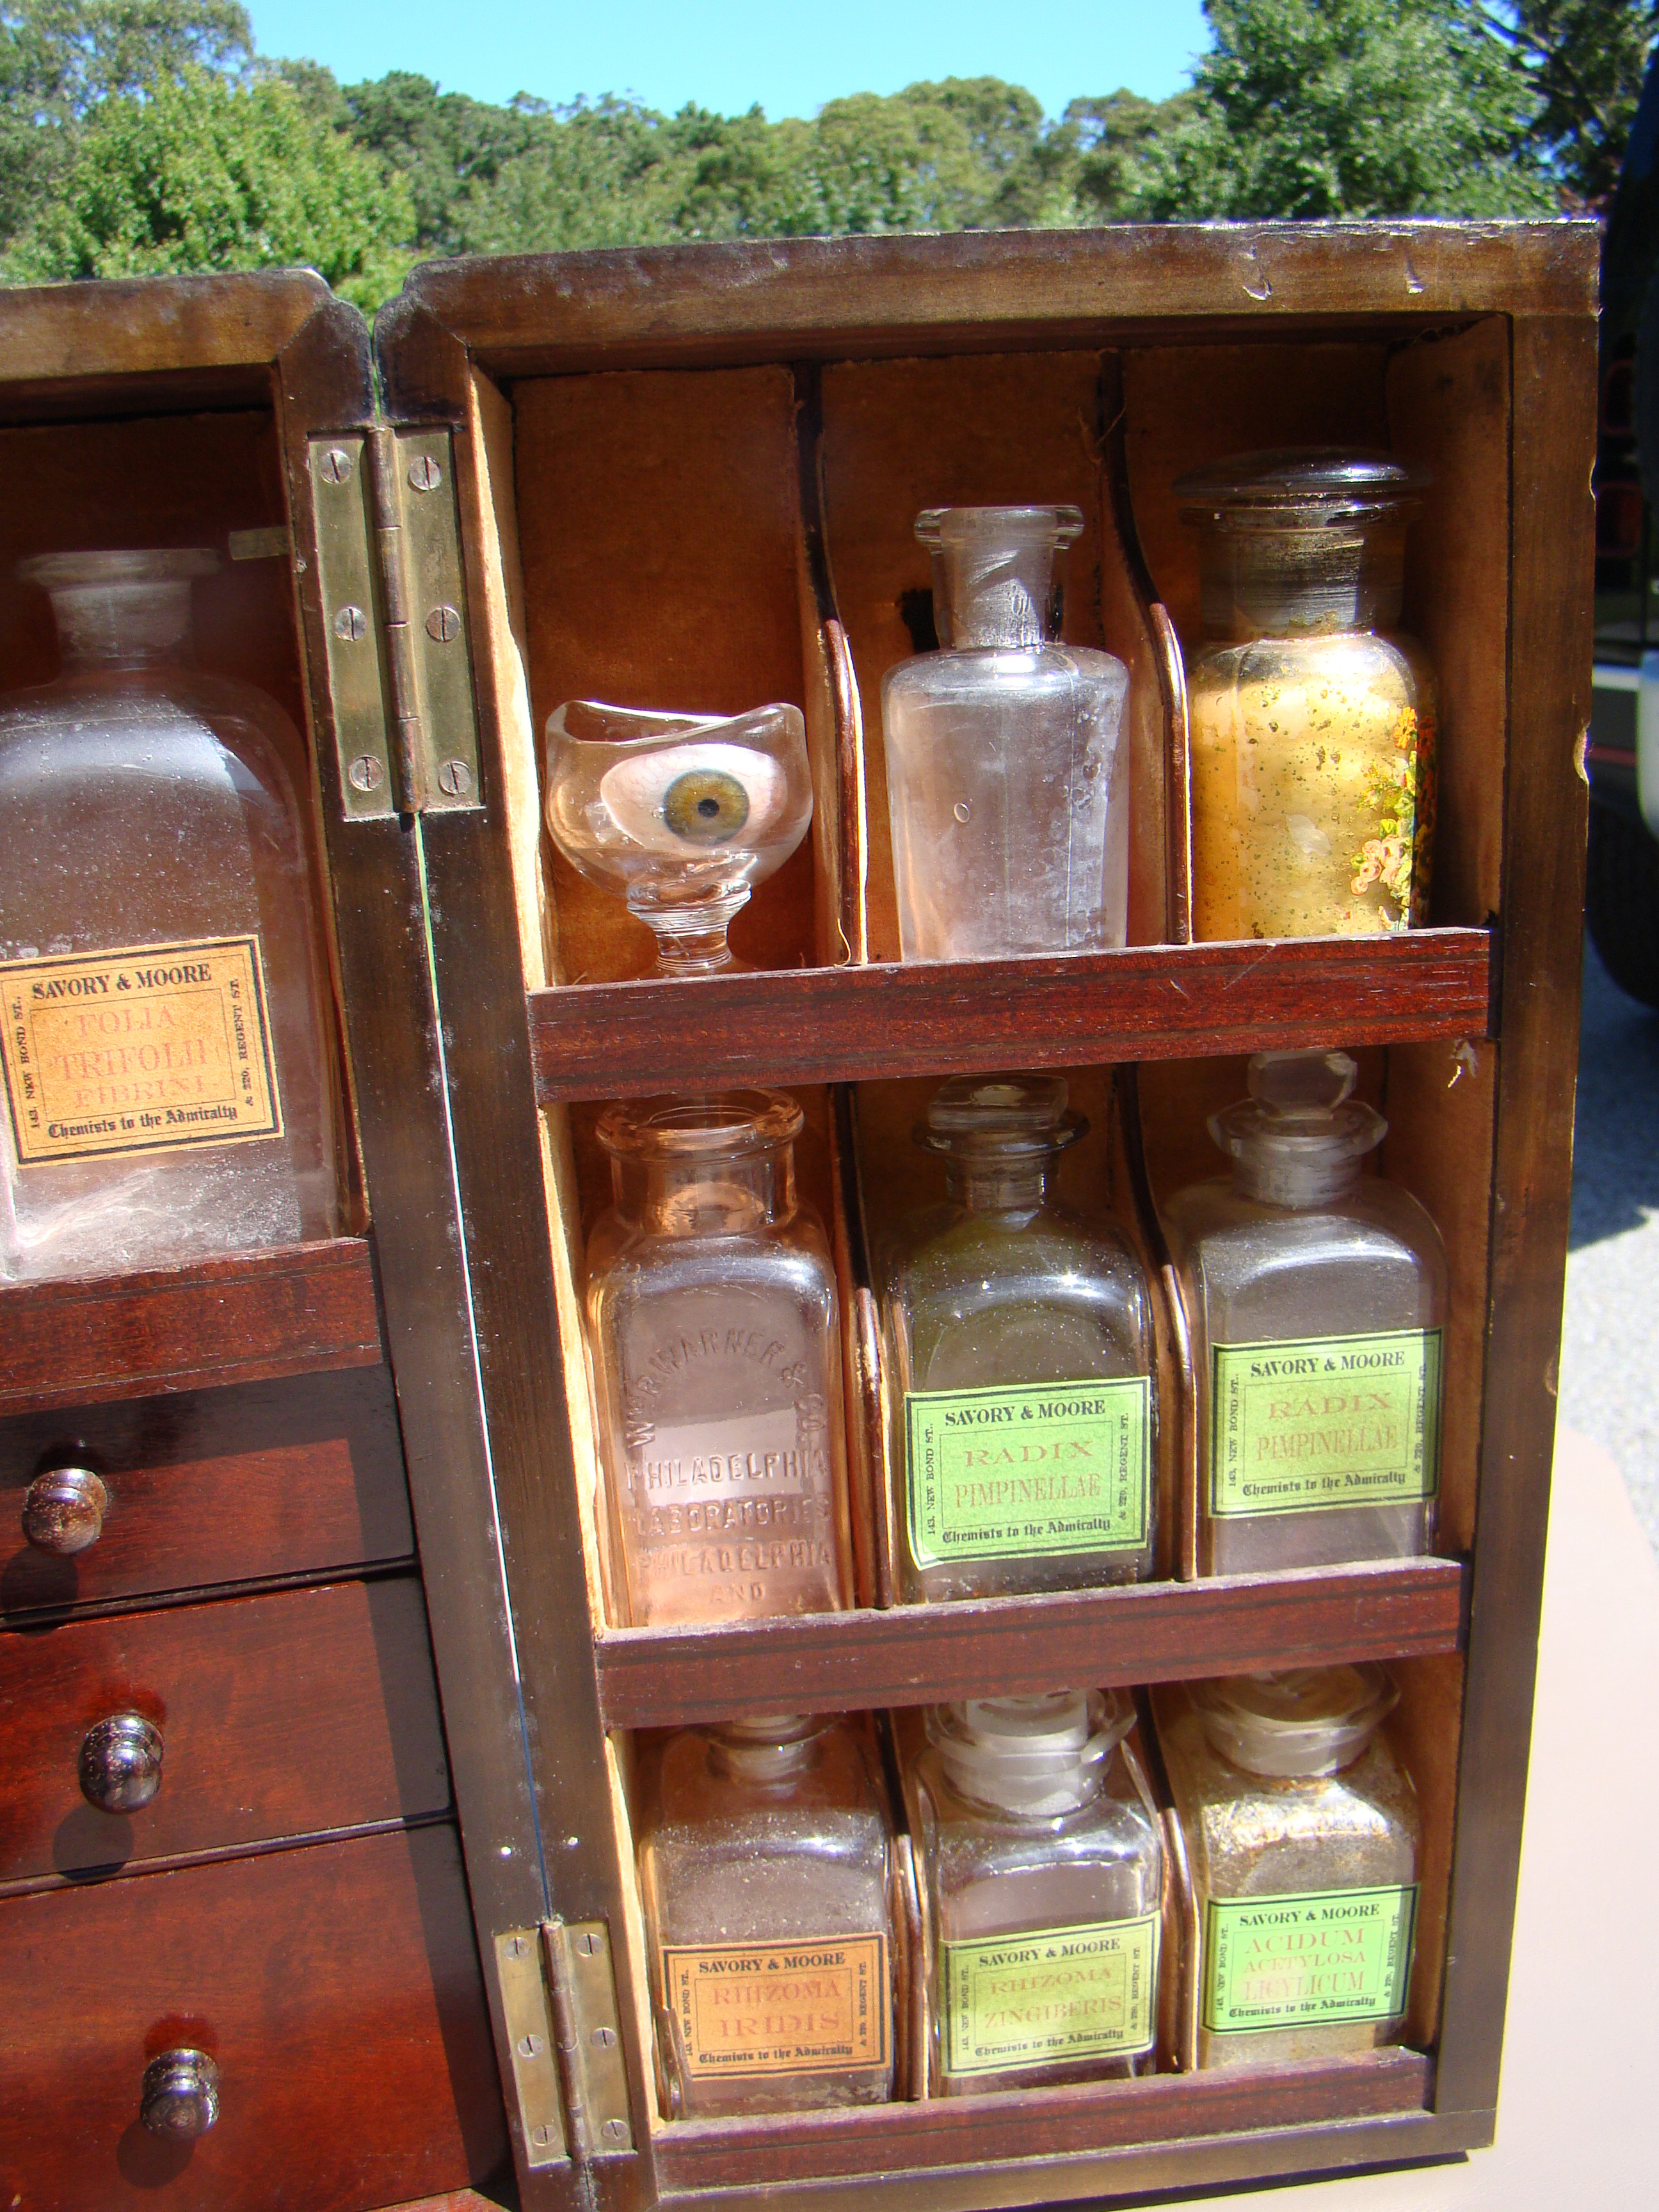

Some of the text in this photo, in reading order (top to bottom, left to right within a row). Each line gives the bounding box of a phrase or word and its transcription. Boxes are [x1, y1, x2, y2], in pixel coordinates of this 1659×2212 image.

[33, 964, 211, 1000] SAVORY & MOORE
[229, 979, 239, 996] ST.
[19, 1027, 30, 1063] BOND
[233, 1005, 247, 1060] REGENT
[26, 1072, 36, 1098] NEW
[245, 1097, 253, 1106] &
[49, 1105, 237, 1138] Chemists to the Admiralty
[649, 1328, 785, 1375] WARNER
[1251, 1351, 1405, 1377] SAVORY & MOORE
[945, 1400, 1105, 1426] SAVORY & MOORE
[1269, 1392, 1393, 1419] RADIX
[966, 1441, 1094, 1467] RADIX
[1257, 1425, 1398, 1461] PIMPINELLAE
[623, 1449, 828, 1490] PHILADELPHIA
[926, 1448, 934, 1480] BOND
[1119, 1438, 1128, 1482] REGENT
[956, 1473, 1102, 1509] PIMPINELLAE
[1243, 1471, 1406, 1497] Chemists to the Admiralty
[926, 1487, 936, 1509] NEW
[635, 1496, 831, 1536] LABORATORIES
[1119, 1510, 1126, 1520] &
[943, 1516, 1110, 1543] Chemists to the Admiralty
[636, 1539, 832, 1576] PHILADELPHIA
[711, 1581, 766, 1602] AND
[1240, 1903, 1379, 1927] SAVORY & MOORE
[979, 1938, 1121, 1967] SAVORY & MOORE
[1246, 1928, 1365, 1953] ACIDUM
[699, 1952, 846, 1974] SAVORY & MOORE
[1243, 1952, 1366, 1973] ACETYLOSA
[713, 1979, 841, 2005] RHIZOMA
[991, 1966, 1112, 1994] RHIZOMA
[1245, 1971, 1365, 2001] LICYLICUM
[984, 1996, 1122, 2029] ZINGIBERIS
[1230, 2008, 1281, 2018] Chemists
[1301, 2003, 1317, 2012] the
[1320, 1996, 1376, 2009] Admiralty
[721, 2011, 839, 2037] IRIDIS
[699, 2044, 853, 2063] Chemists to the Admiralty
[975, 2030, 1123, 2056] Chemists to the Admiralty
